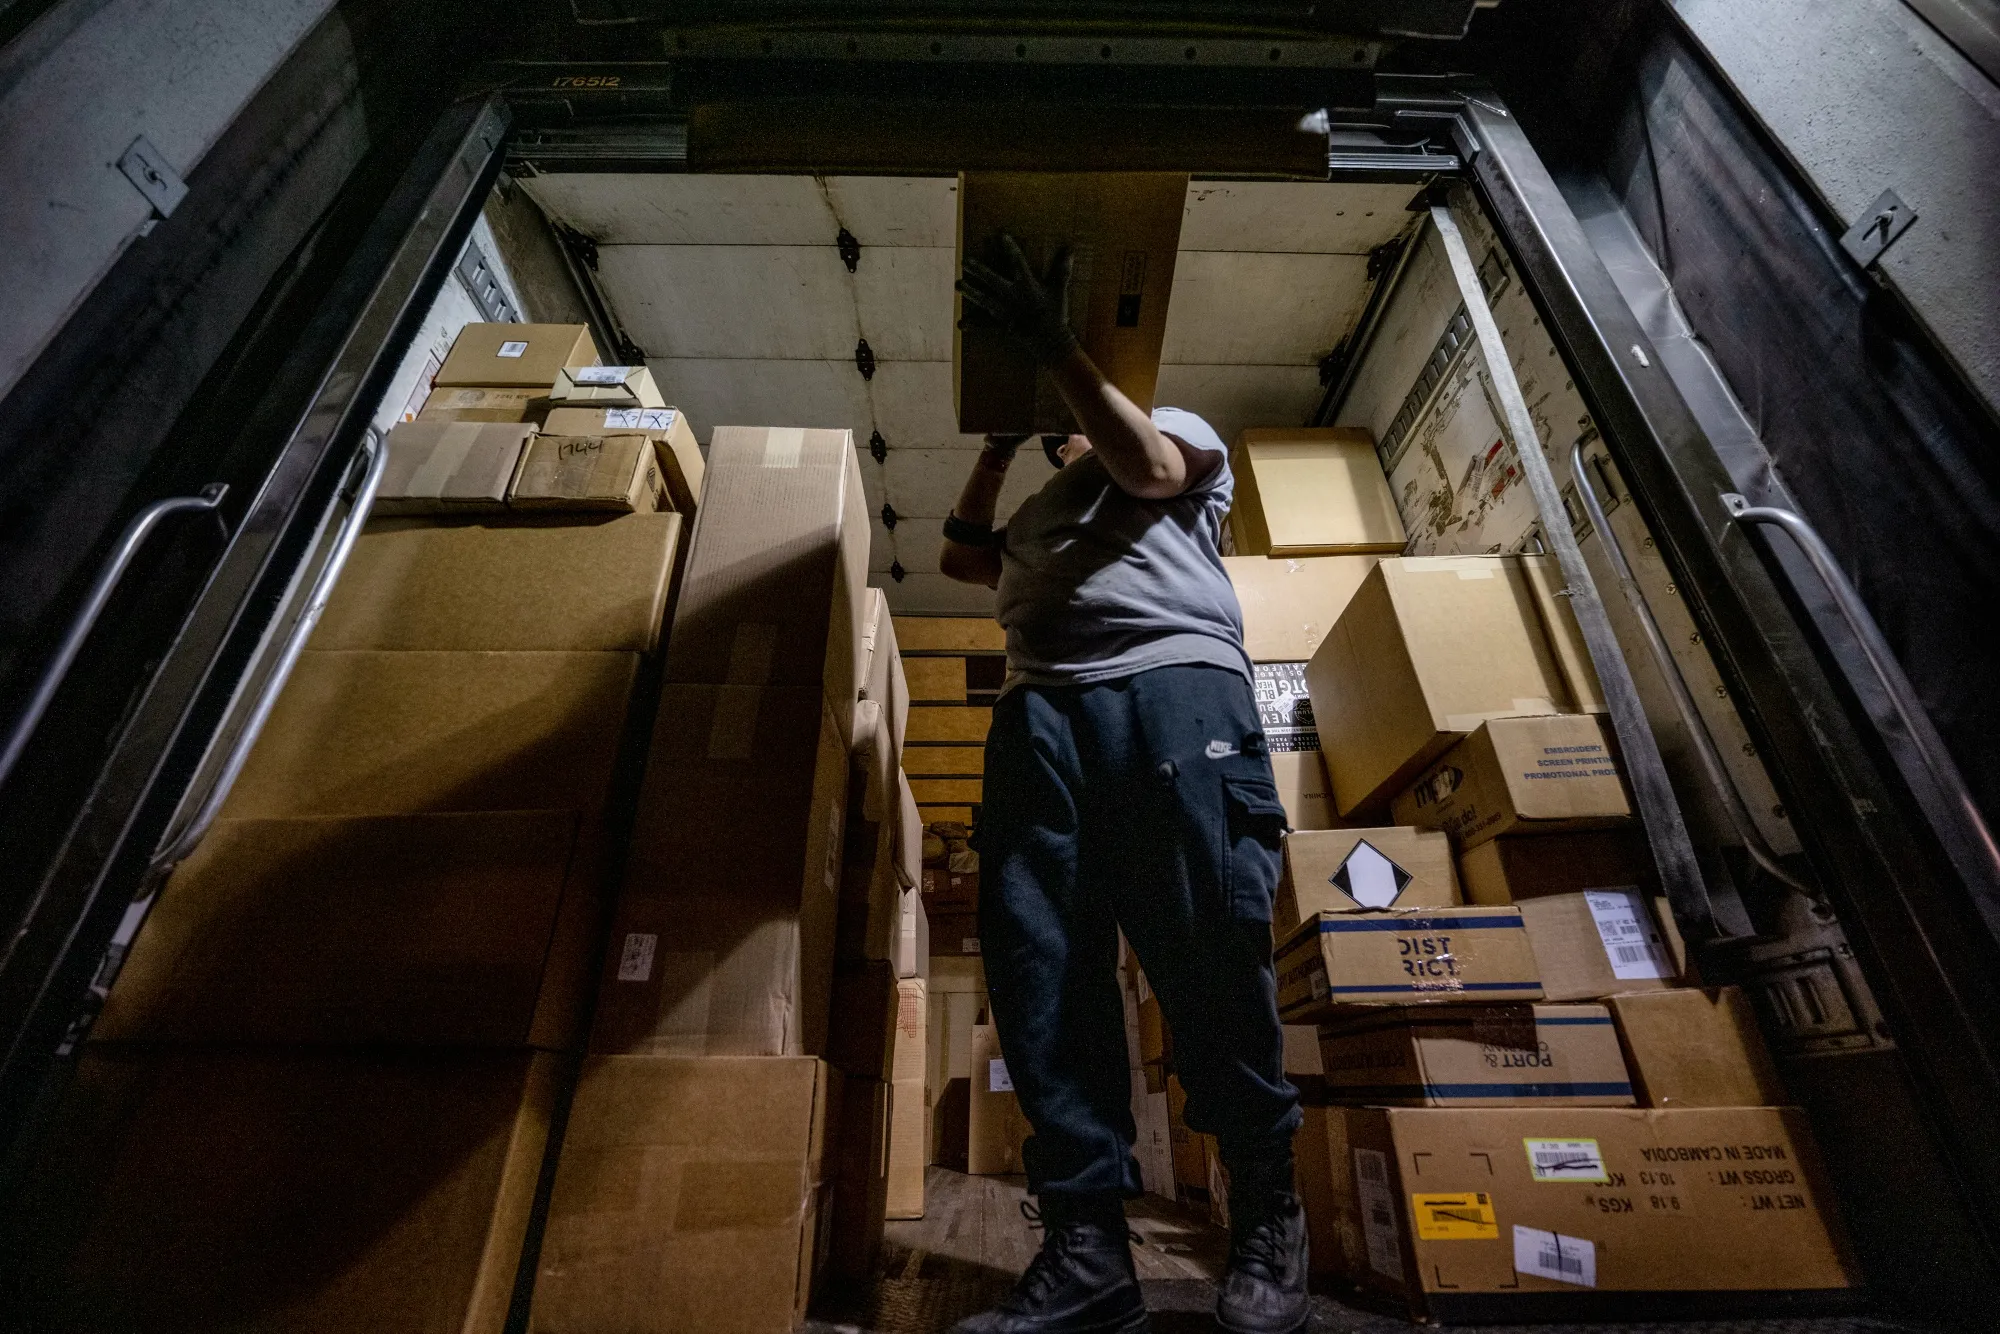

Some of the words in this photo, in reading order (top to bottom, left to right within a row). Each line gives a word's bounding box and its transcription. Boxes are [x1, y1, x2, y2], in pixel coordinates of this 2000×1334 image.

[553, 76, 621, 87] 176512
[1261, 713, 1291, 724] NEV
[1544, 744, 1602, 755] EMBROIDERY
[1537, 758, 1573, 767] SCREEN
[1523, 770, 1590, 780] PROMOTIONAL
[1397, 936, 1451, 956] DIST
[1484, 1053, 1498, 1067] &
[1502, 1052, 1553, 1068] PORT
[1640, 1146, 1722, 1162] CAMBODIA
[1725, 1146, 1740, 1161] IN
[1741, 1144, 1787, 1161] MADE
[1639, 1170, 1675, 1186] 10.13
[1716, 1169, 1742, 1186] WT
[1742, 1168, 1795, 1186] GROSS
[1598, 1197, 1634, 1213] KGS
[1750, 1195, 1774, 1210] WT
[1775, 1193, 1806, 1210] NET
